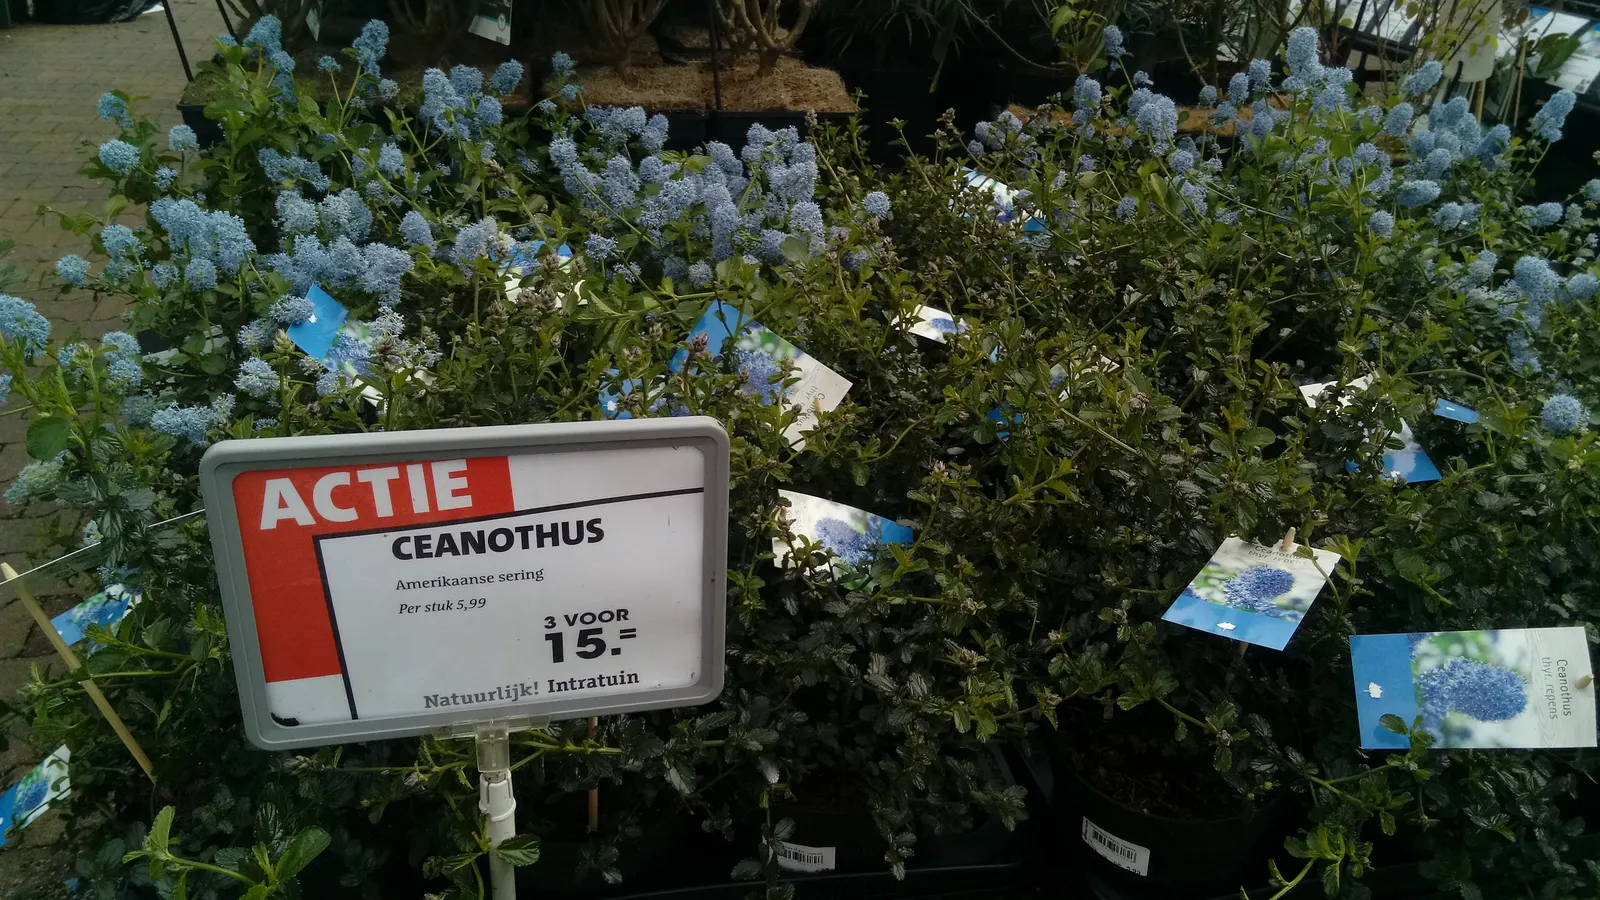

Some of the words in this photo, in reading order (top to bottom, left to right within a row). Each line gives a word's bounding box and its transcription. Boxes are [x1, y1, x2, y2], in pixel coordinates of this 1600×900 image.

[260, 459, 472, 530] ACTIE
[391, 518, 605, 560] CEANOTHUS
[396, 574, 495, 591] Amerikaanse
[498, 568, 545, 582] sering
[398, 603, 422, 614] Per
[424, 599, 453, 612] stuk
[456, 597, 486, 612] 5,99
[544, 616, 556, 629] 3
[563, 609, 629, 627] VOOR
[423, 681, 539, 709] Natuurlijk!
[547, 670, 640, 693] Intratuin
[1545, 684, 1558, 719] repens
[1557, 660, 1572, 716] Ceanothus
